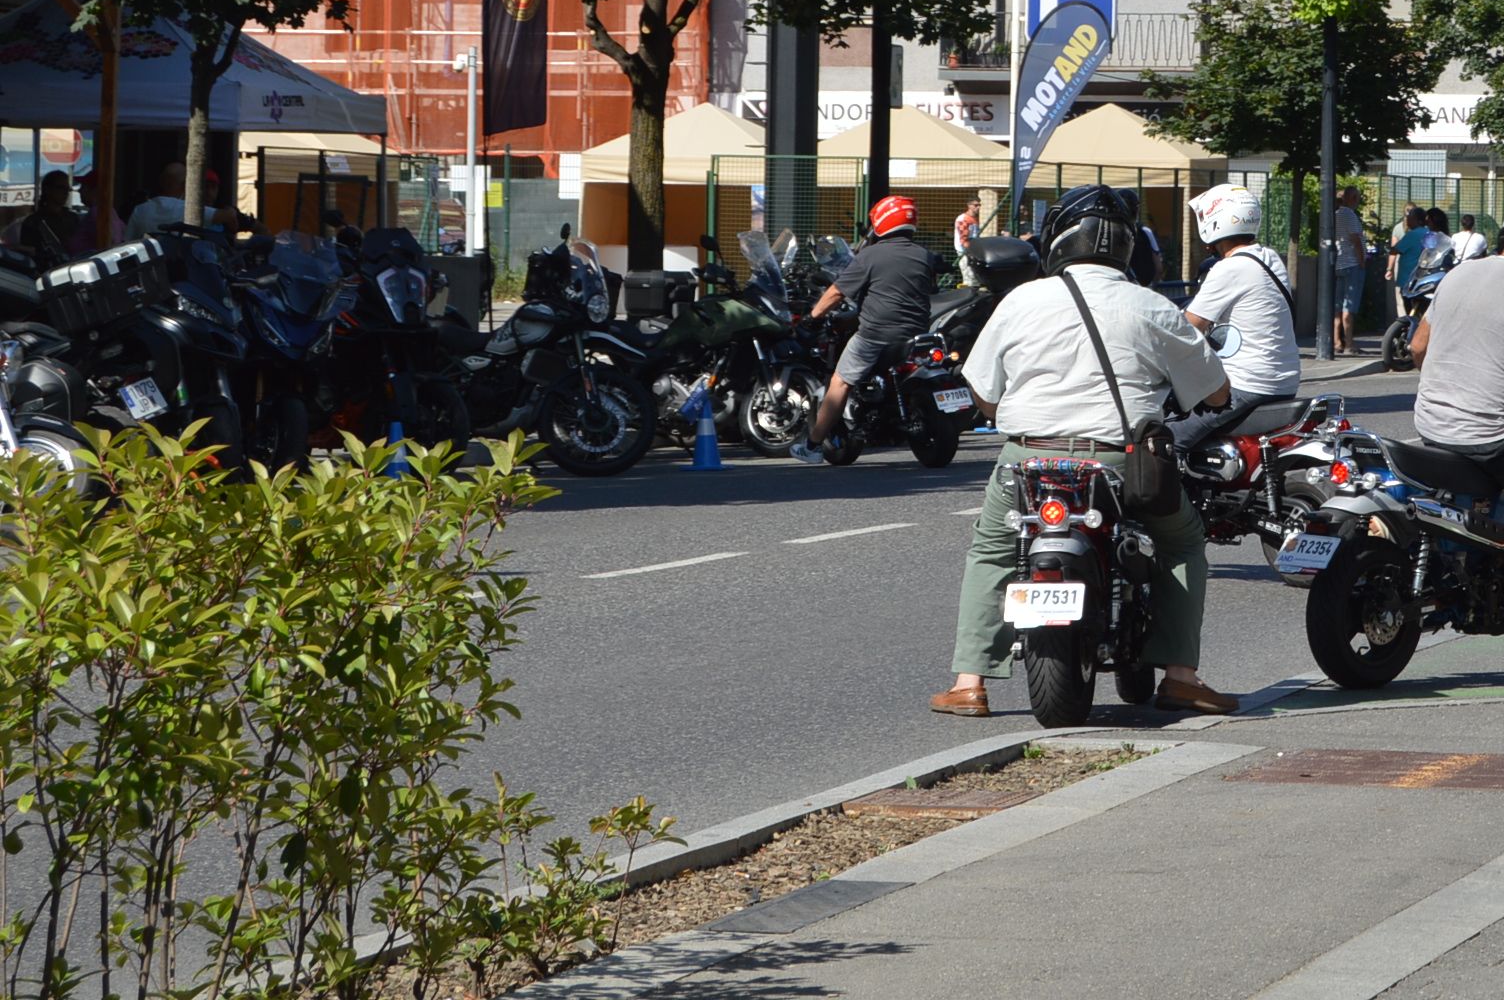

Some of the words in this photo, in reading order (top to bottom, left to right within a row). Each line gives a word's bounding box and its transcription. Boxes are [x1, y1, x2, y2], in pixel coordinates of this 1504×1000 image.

[1020, 24, 1098, 132] MOTAND
[916, 103, 995, 121] FUSTES
[1297, 540, 1334, 556] R2354
[1030, 589, 1078, 605] P7531
